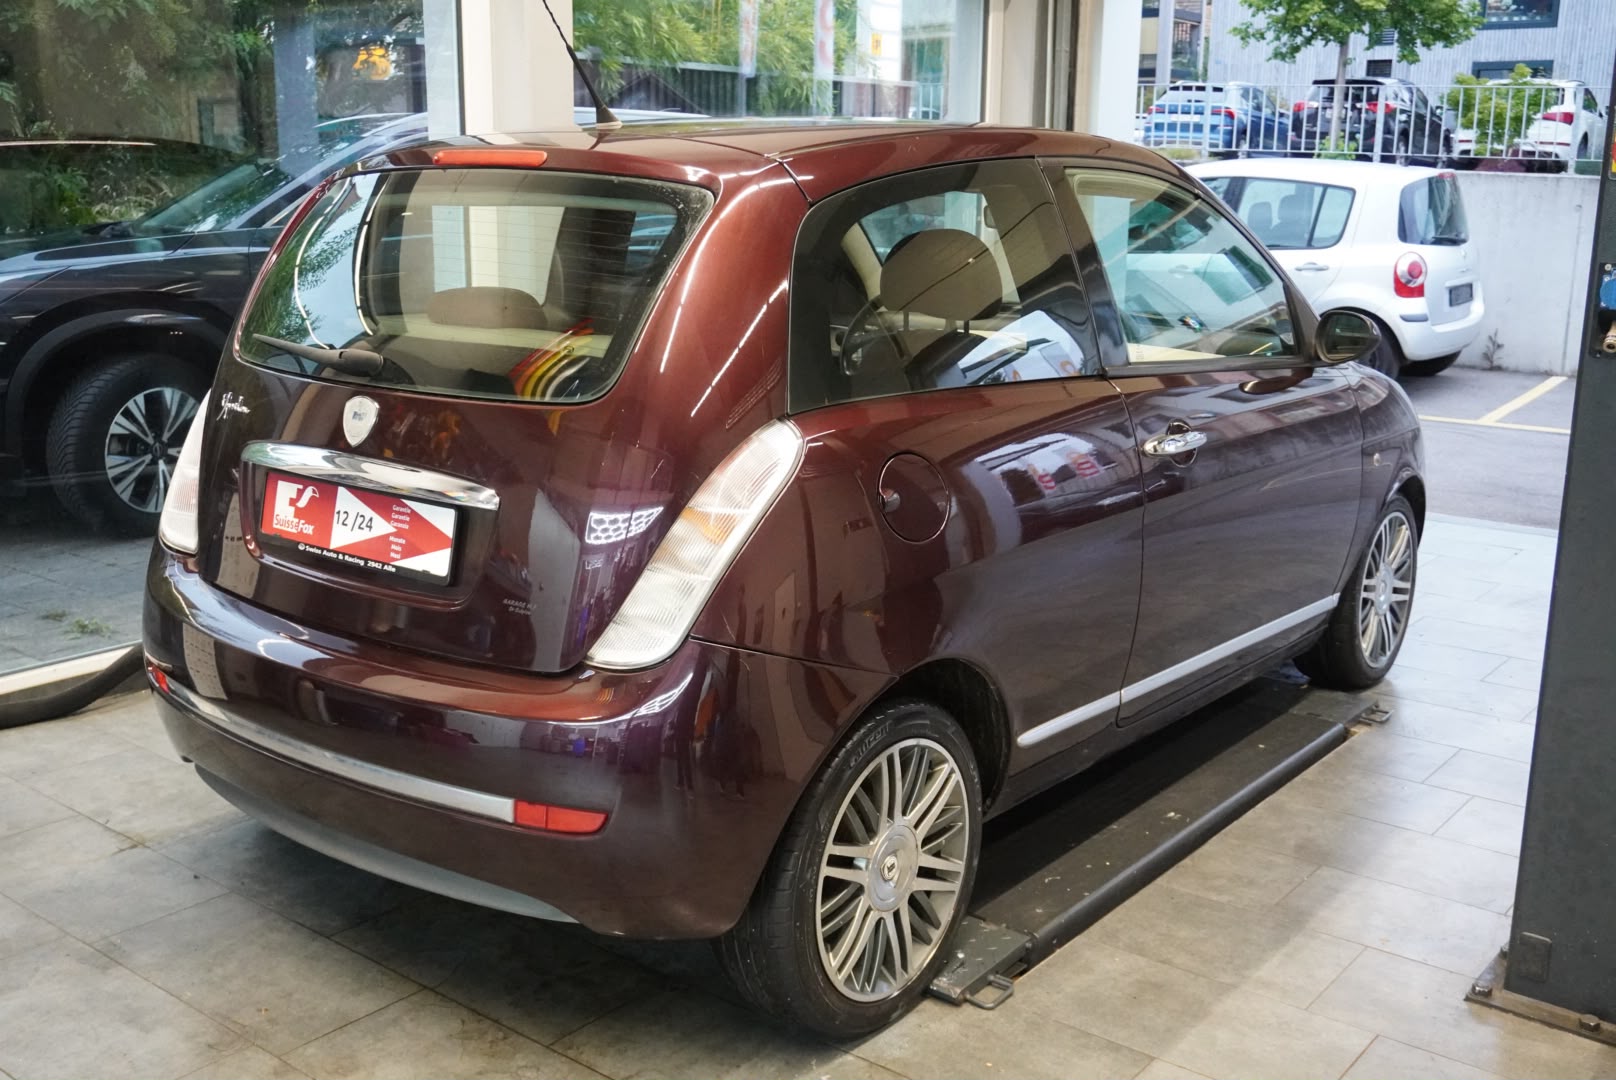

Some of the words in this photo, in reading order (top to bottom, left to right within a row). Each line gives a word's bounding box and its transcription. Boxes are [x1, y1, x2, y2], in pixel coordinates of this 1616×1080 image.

[305, 545, 322, 554] Swiss
[322, 549, 337, 559] Auto
[344, 555, 365, 566] Racing
[367, 560, 382, 570] 2942
[383, 564, 396, 573] Alle
